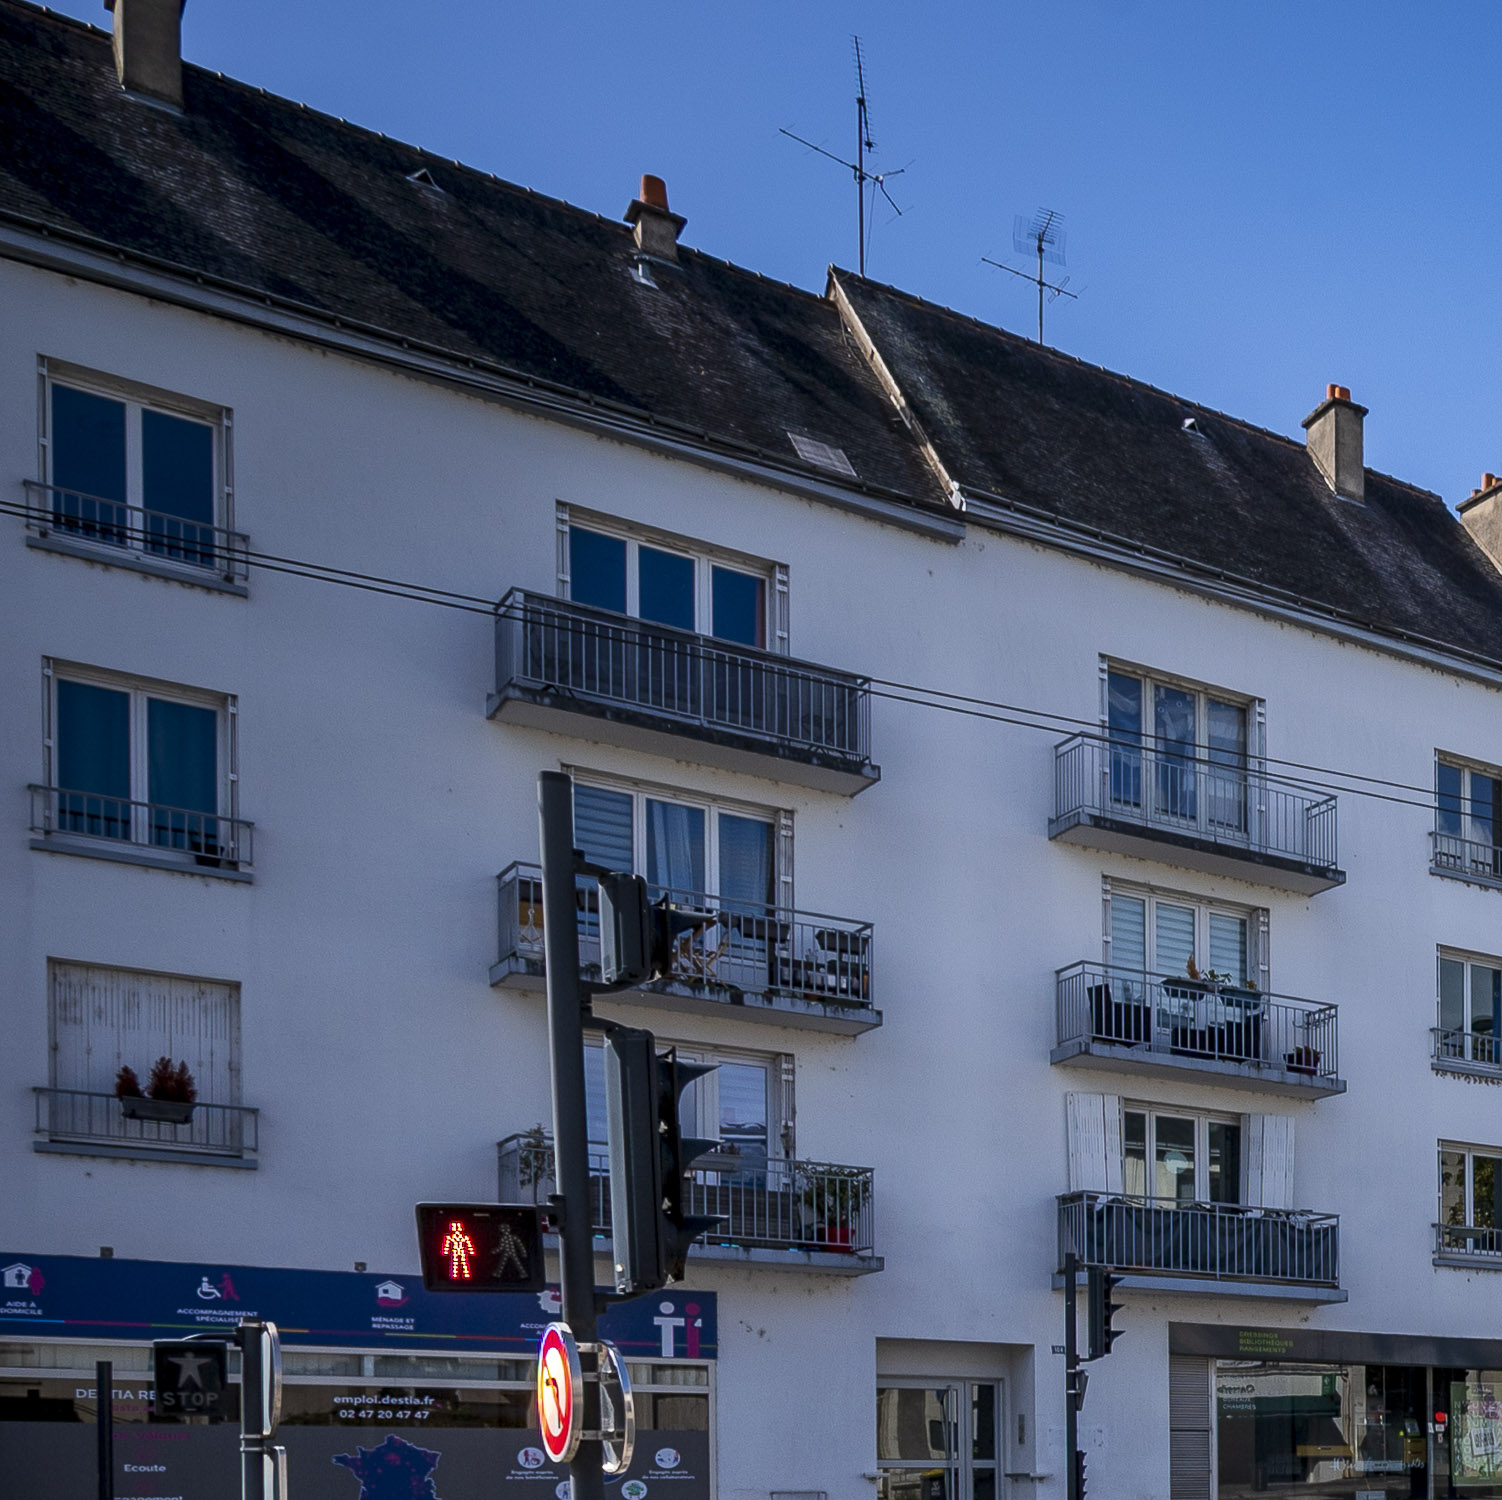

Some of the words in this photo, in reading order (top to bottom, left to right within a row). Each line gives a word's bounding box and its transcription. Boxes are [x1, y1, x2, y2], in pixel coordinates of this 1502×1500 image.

[177, 1308, 259, 1317] ACCOMPAGNEMENT
[371, 1316, 403, 1324] MÉNAGE
[404, 1317, 415, 1325] ET
[372, 1323, 415, 1331] REPASSAGE
[75, 1388, 135, 1400] DETIA
[162, 1391, 219, 1407] STOP
[333, 1393, 436, 1406] emploi.destia.fr
[339, 1409, 355, 1419] 02
[357, 1410, 375, 1419] 47
[377, 1410, 393, 1420] 20
[395, 1410, 412, 1420] 47
[414, 1410, 430, 1420] 47
[123, 1463, 167, 1474] Ecoute
